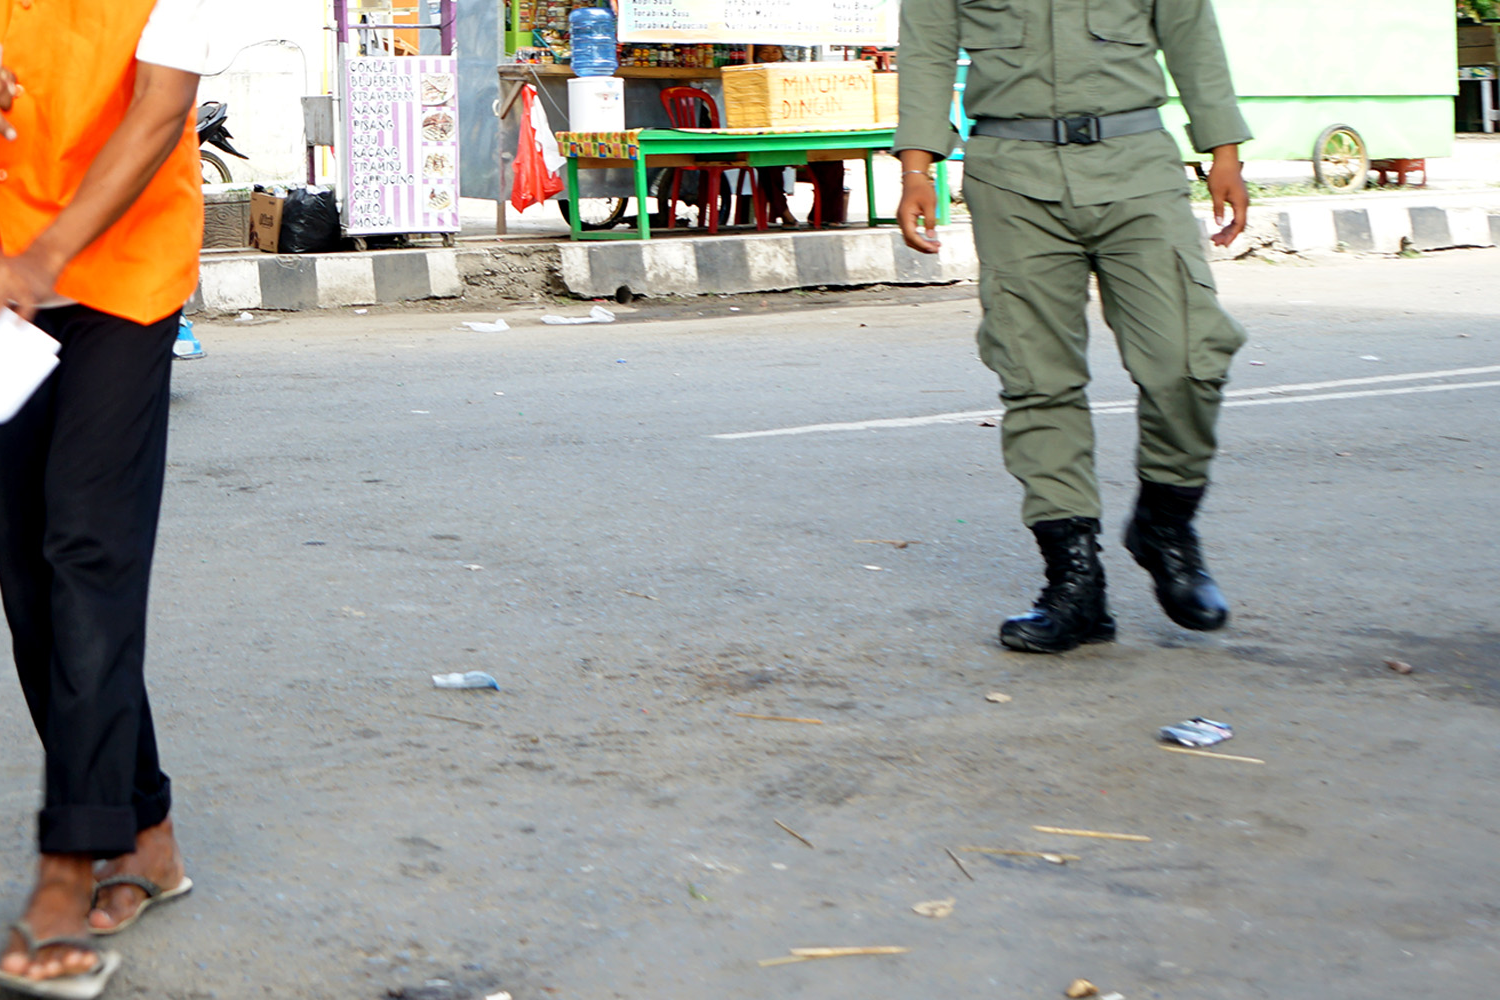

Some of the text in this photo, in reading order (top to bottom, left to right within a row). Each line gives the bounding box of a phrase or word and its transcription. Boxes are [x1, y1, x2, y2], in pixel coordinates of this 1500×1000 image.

[350, 61, 394, 72] COKLAT
[352, 91, 414, 102] STRAWBERRY
[353, 105, 389, 115] NANAS
[782, 96, 842, 119] DINGIN
[353, 119, 393, 131] PISANG
[353, 135, 377, 145] KEJU
[353, 147, 397, 158] KACANG
[354, 161, 401, 172] TIRAMISU
[354, 174, 414, 186] CAPPUCINO
[354, 189, 380, 200] OREO
[355, 216, 392, 227] MOCCA
